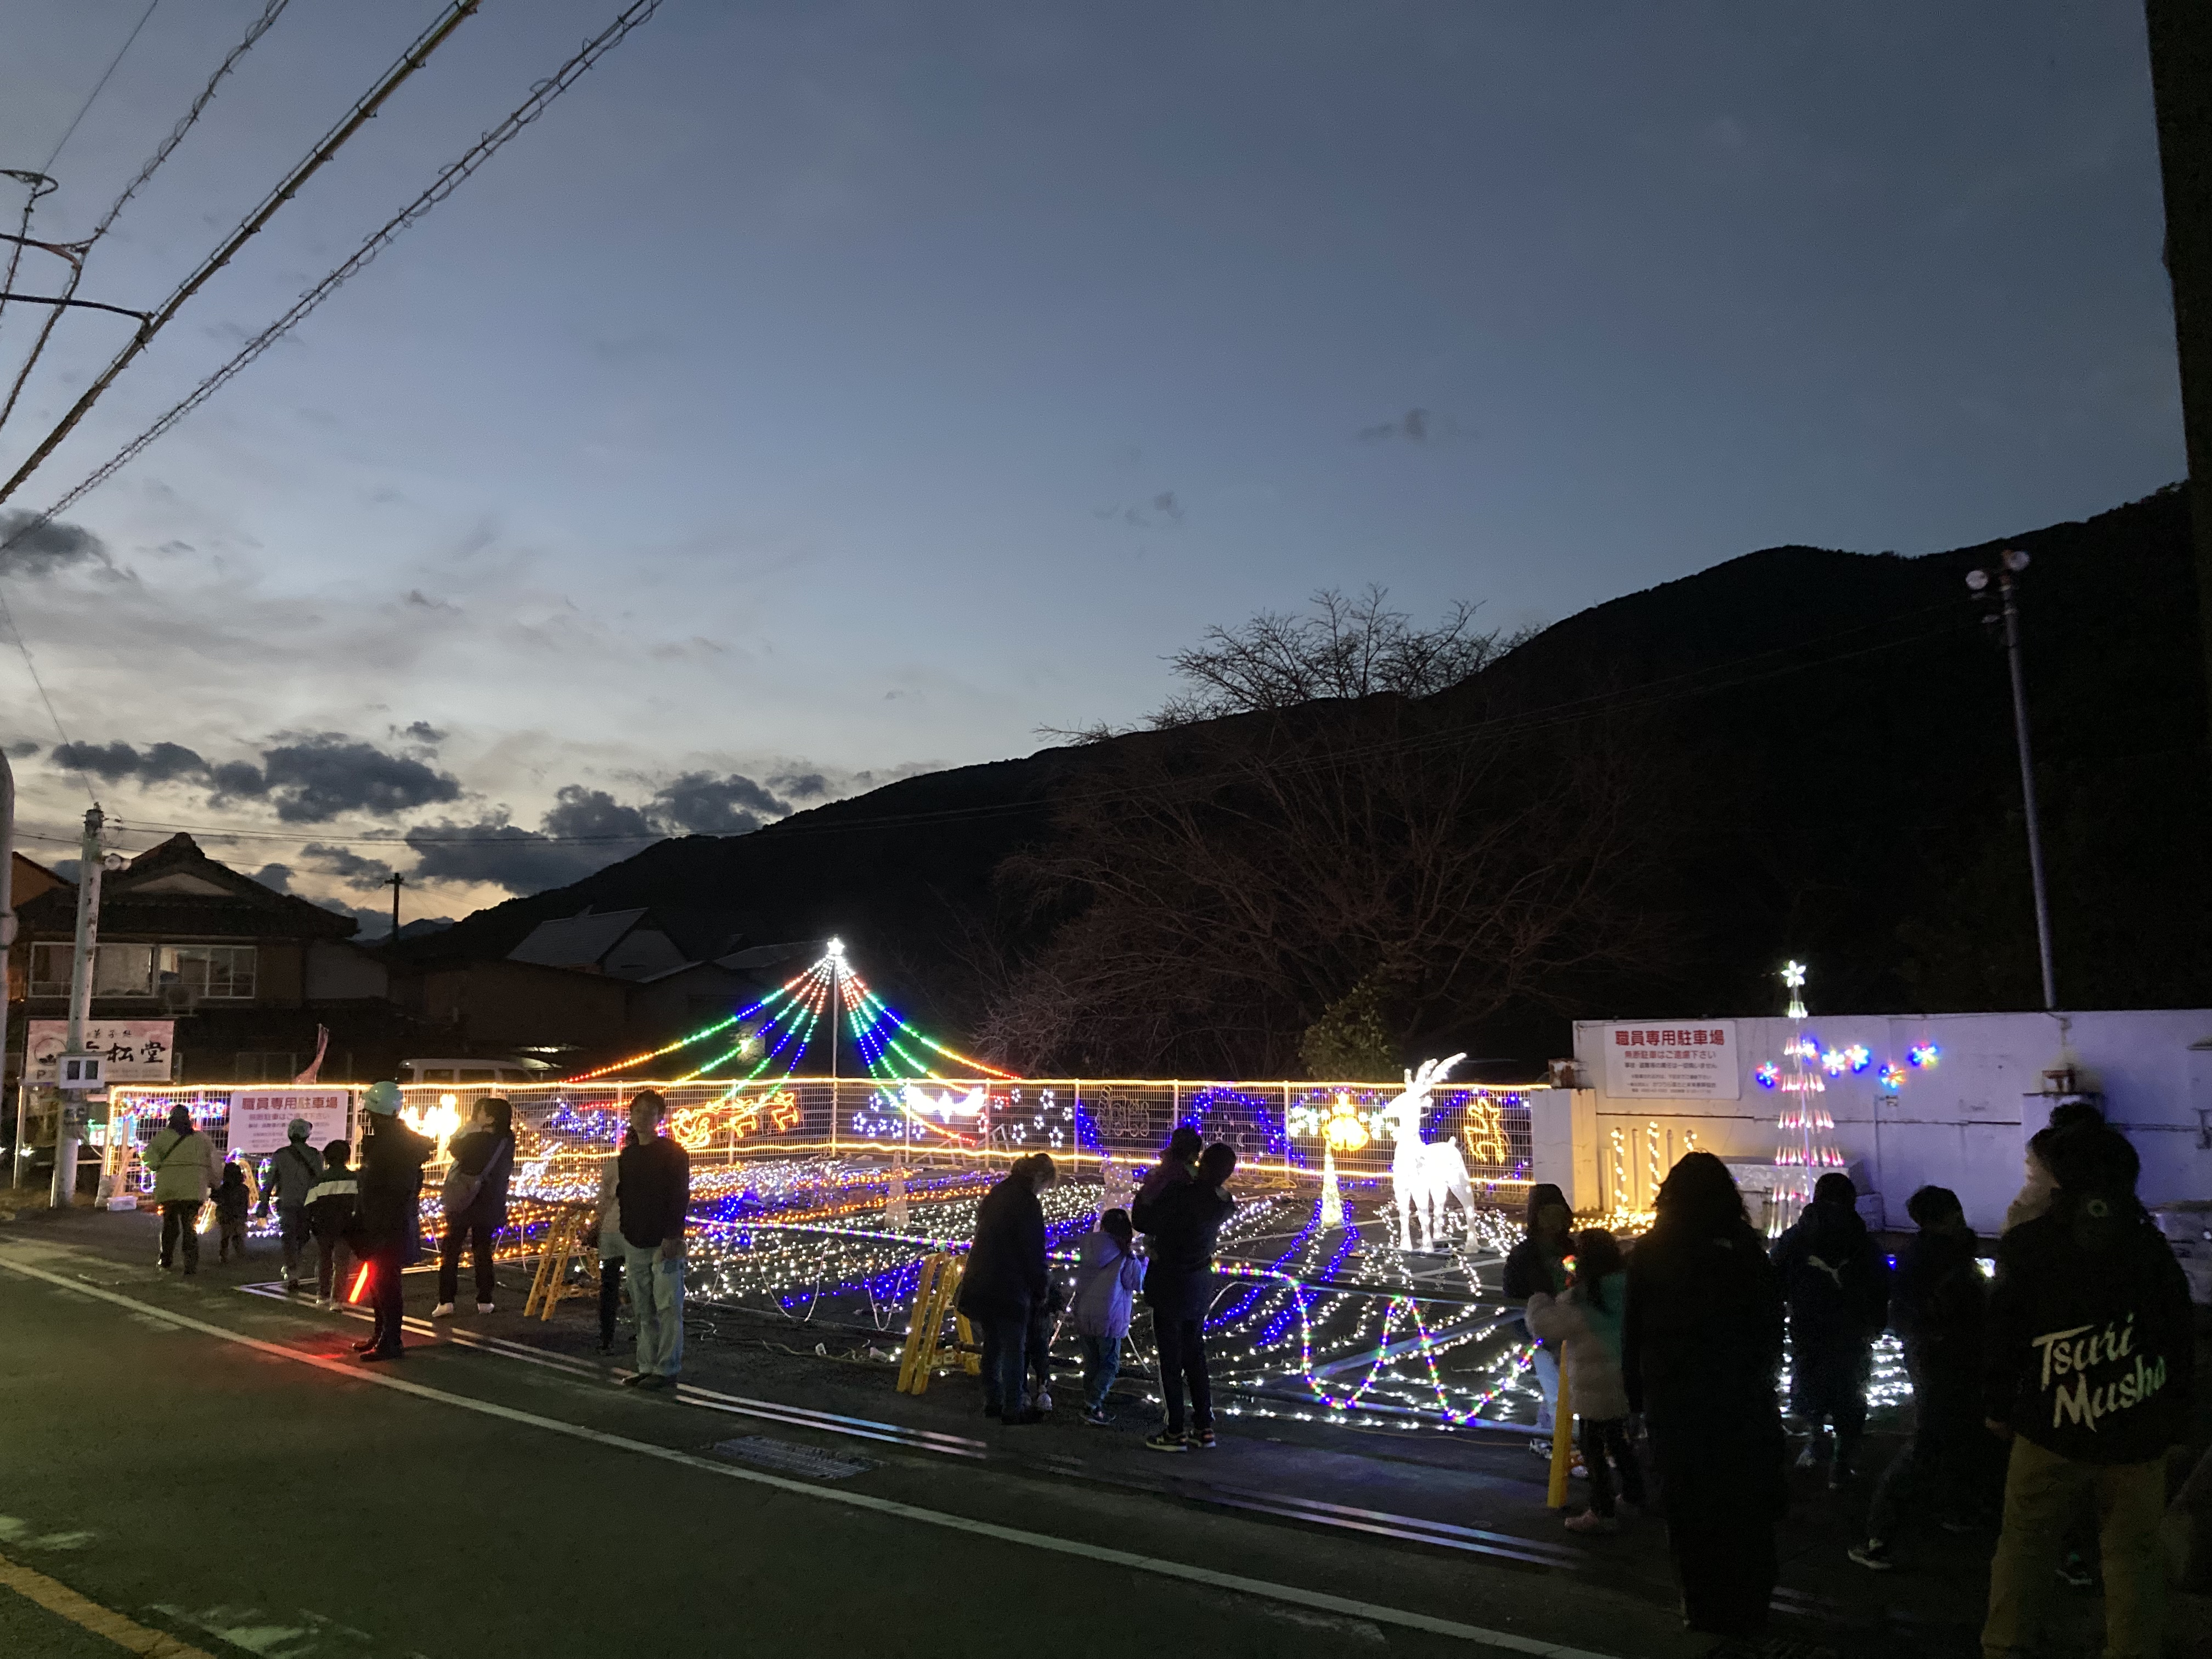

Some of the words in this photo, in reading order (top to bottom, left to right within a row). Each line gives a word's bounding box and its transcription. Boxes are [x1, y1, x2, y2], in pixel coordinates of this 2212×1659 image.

[1615, 1030, 1725, 1046] 職員専用駐車場
[2032, 1312, 2136, 1392] Tsuri
